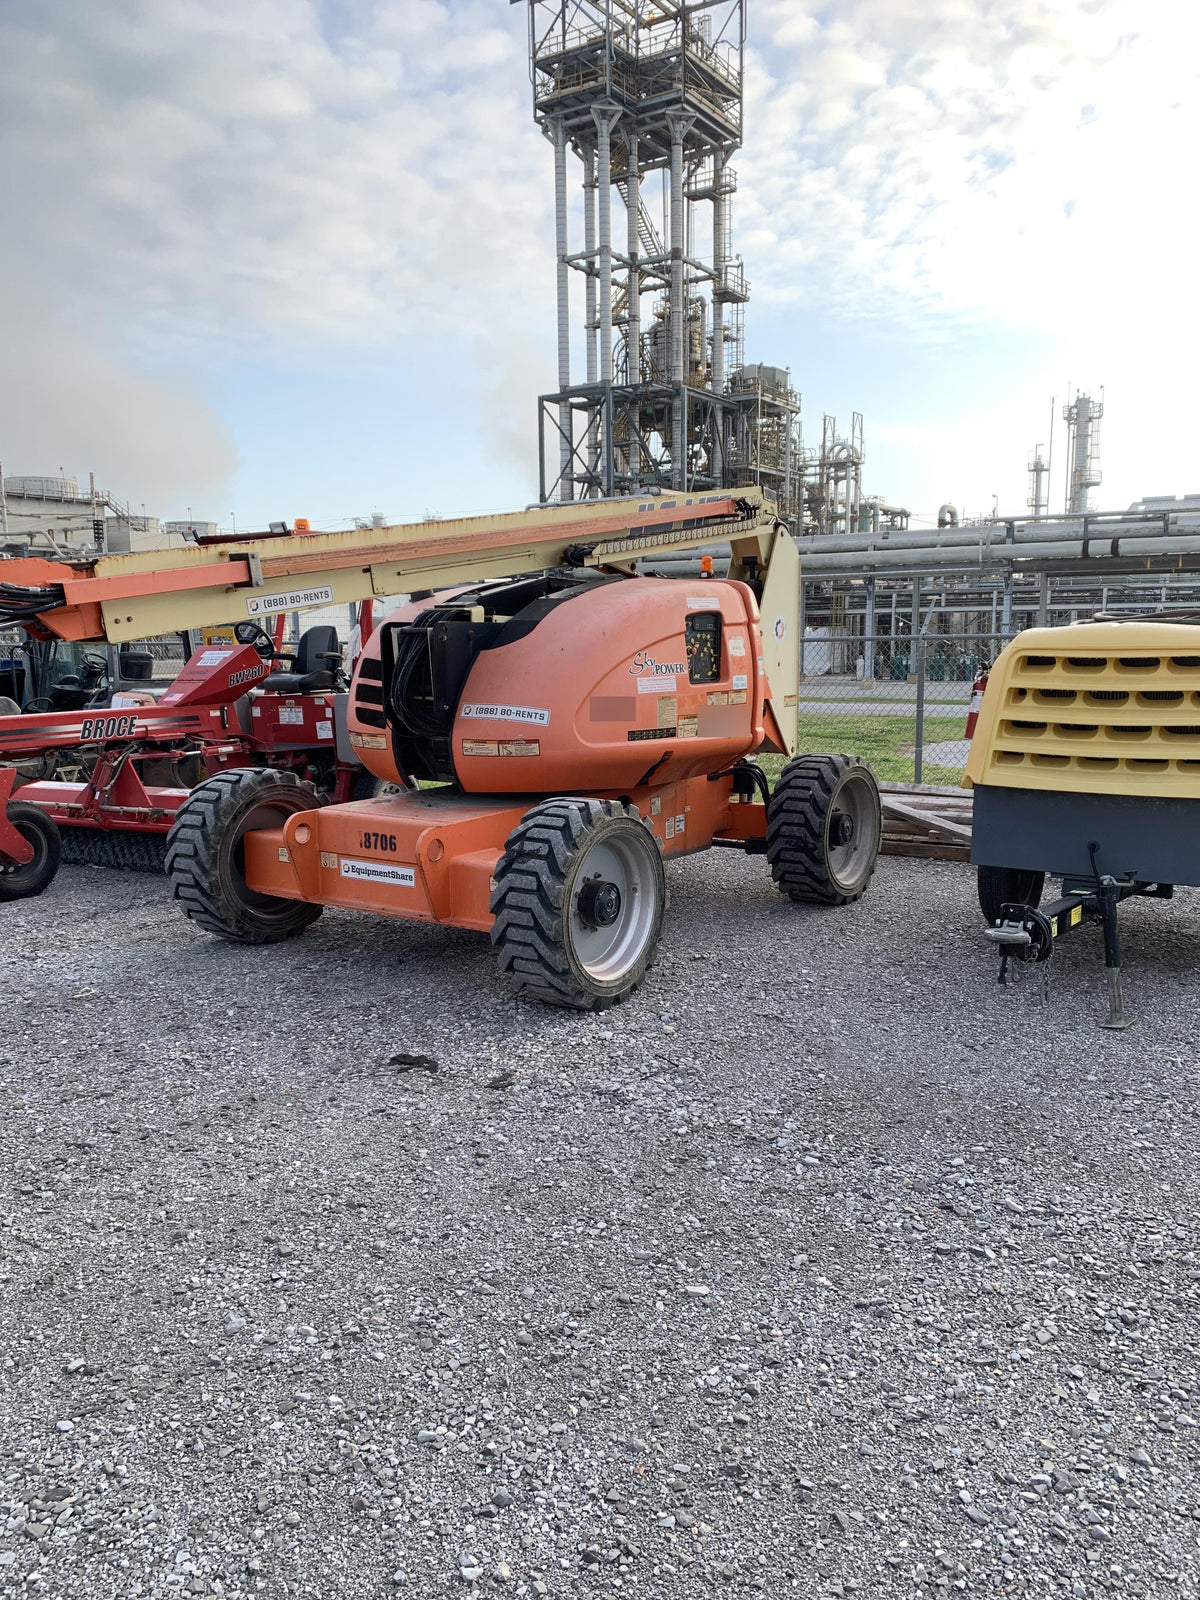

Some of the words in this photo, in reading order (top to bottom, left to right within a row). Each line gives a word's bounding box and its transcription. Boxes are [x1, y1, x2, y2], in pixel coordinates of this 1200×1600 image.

[290, 590, 330, 604] 80-RENTS
[628, 651, 656, 675] Sky
[655, 662, 685, 675] POWER
[228, 663, 264, 687] BW260
[500, 708, 545, 721] 80-RENTS
[80, 715, 138, 740] BROCE
[350, 864, 414, 882] EquipmentShare
